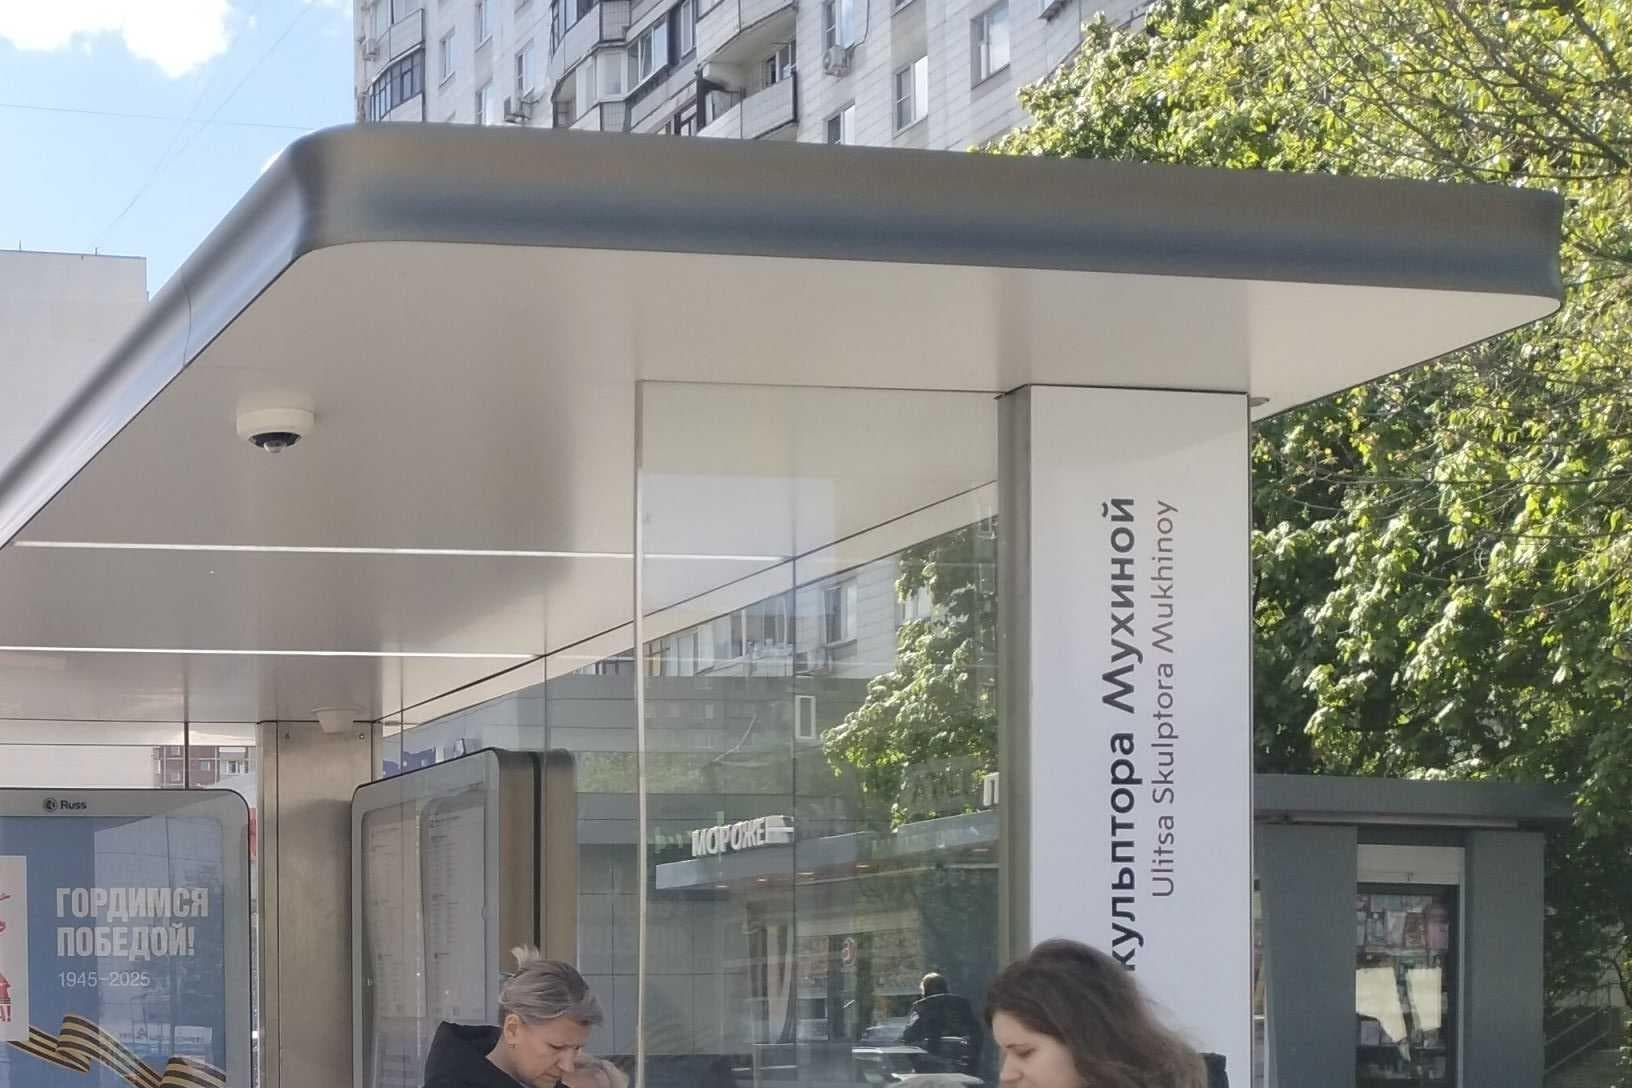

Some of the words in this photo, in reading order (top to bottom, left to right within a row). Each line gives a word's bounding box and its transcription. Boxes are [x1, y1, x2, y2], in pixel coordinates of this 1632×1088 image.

[1102, 498, 1143, 714] Мухиной
[1150, 500, 1179, 653] Mukhinoy
[1151, 663, 1179, 804] Skulptora
[56, 887, 209, 923] ГОРДИМСЯ
[1110, 733, 1144, 971] кульптора
[1151, 815, 1175, 897] Ulitsa
[56, 922, 196, 961] ПОБЕДОЙ!
